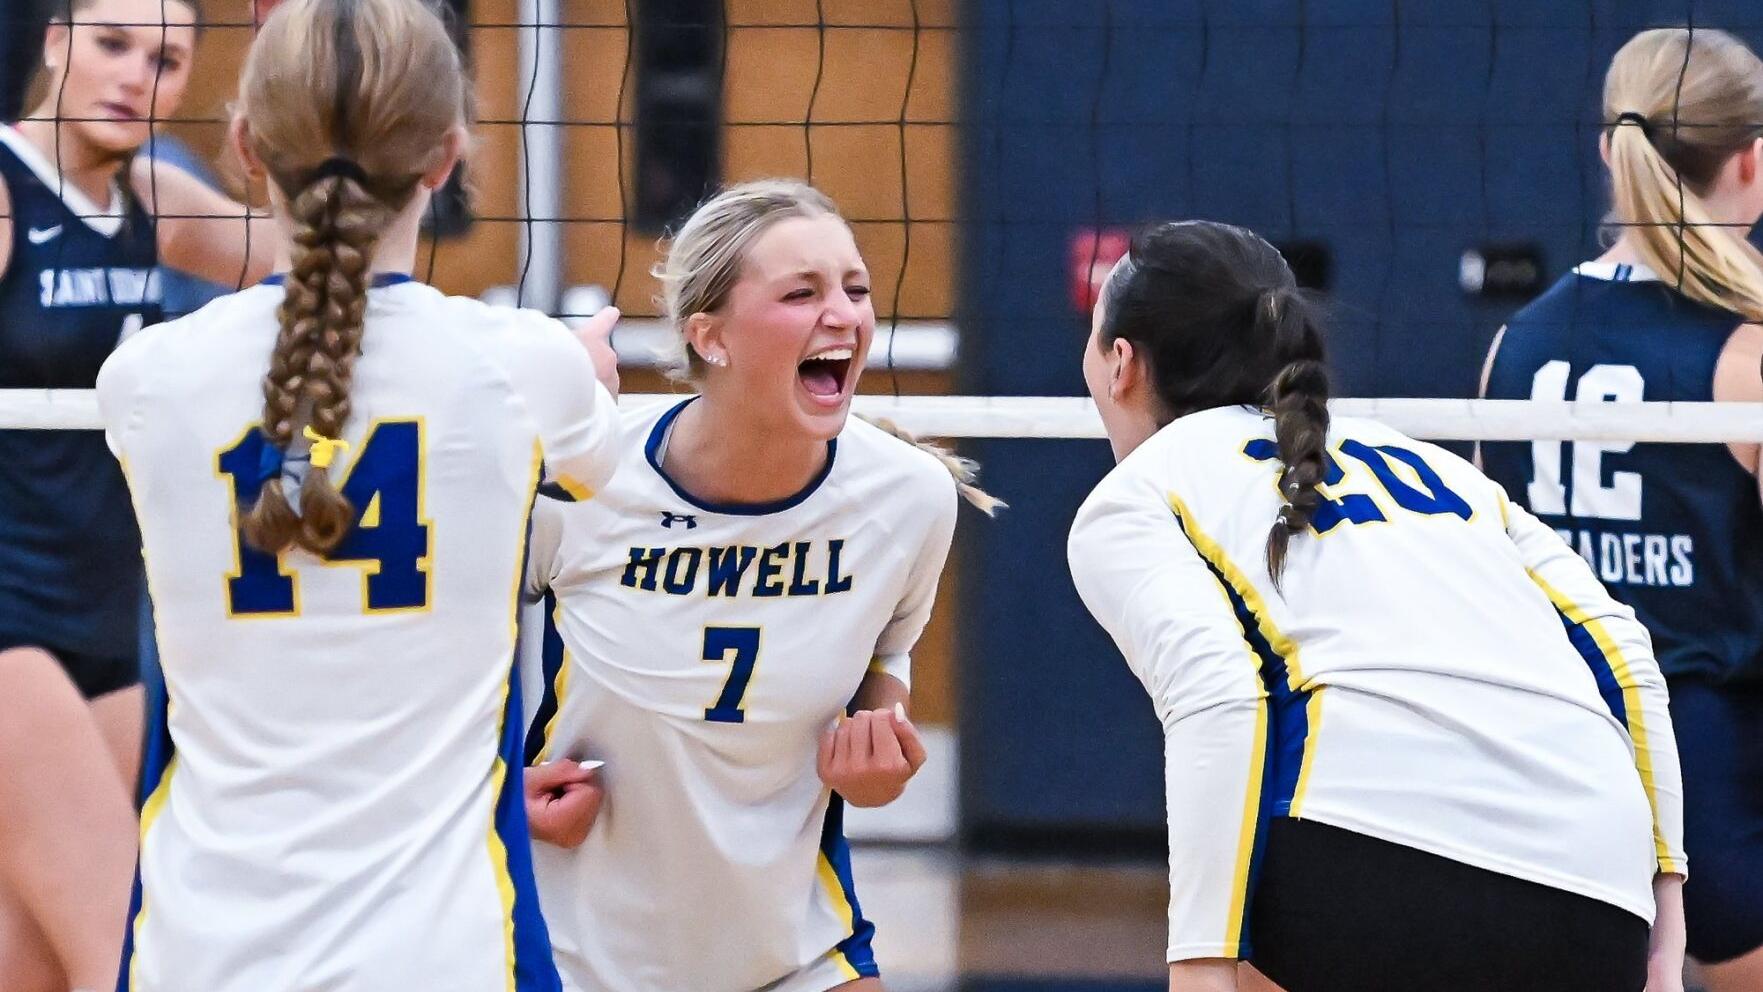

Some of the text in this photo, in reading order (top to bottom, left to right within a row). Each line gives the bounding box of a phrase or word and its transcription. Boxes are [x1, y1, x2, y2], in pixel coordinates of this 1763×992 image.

[1241, 437, 1476, 538] 20
[1528, 360, 1645, 521] 12
[215, 416, 434, 619] 14
[620, 539, 853, 597] HOWELL
[700, 624, 763, 724] 7
